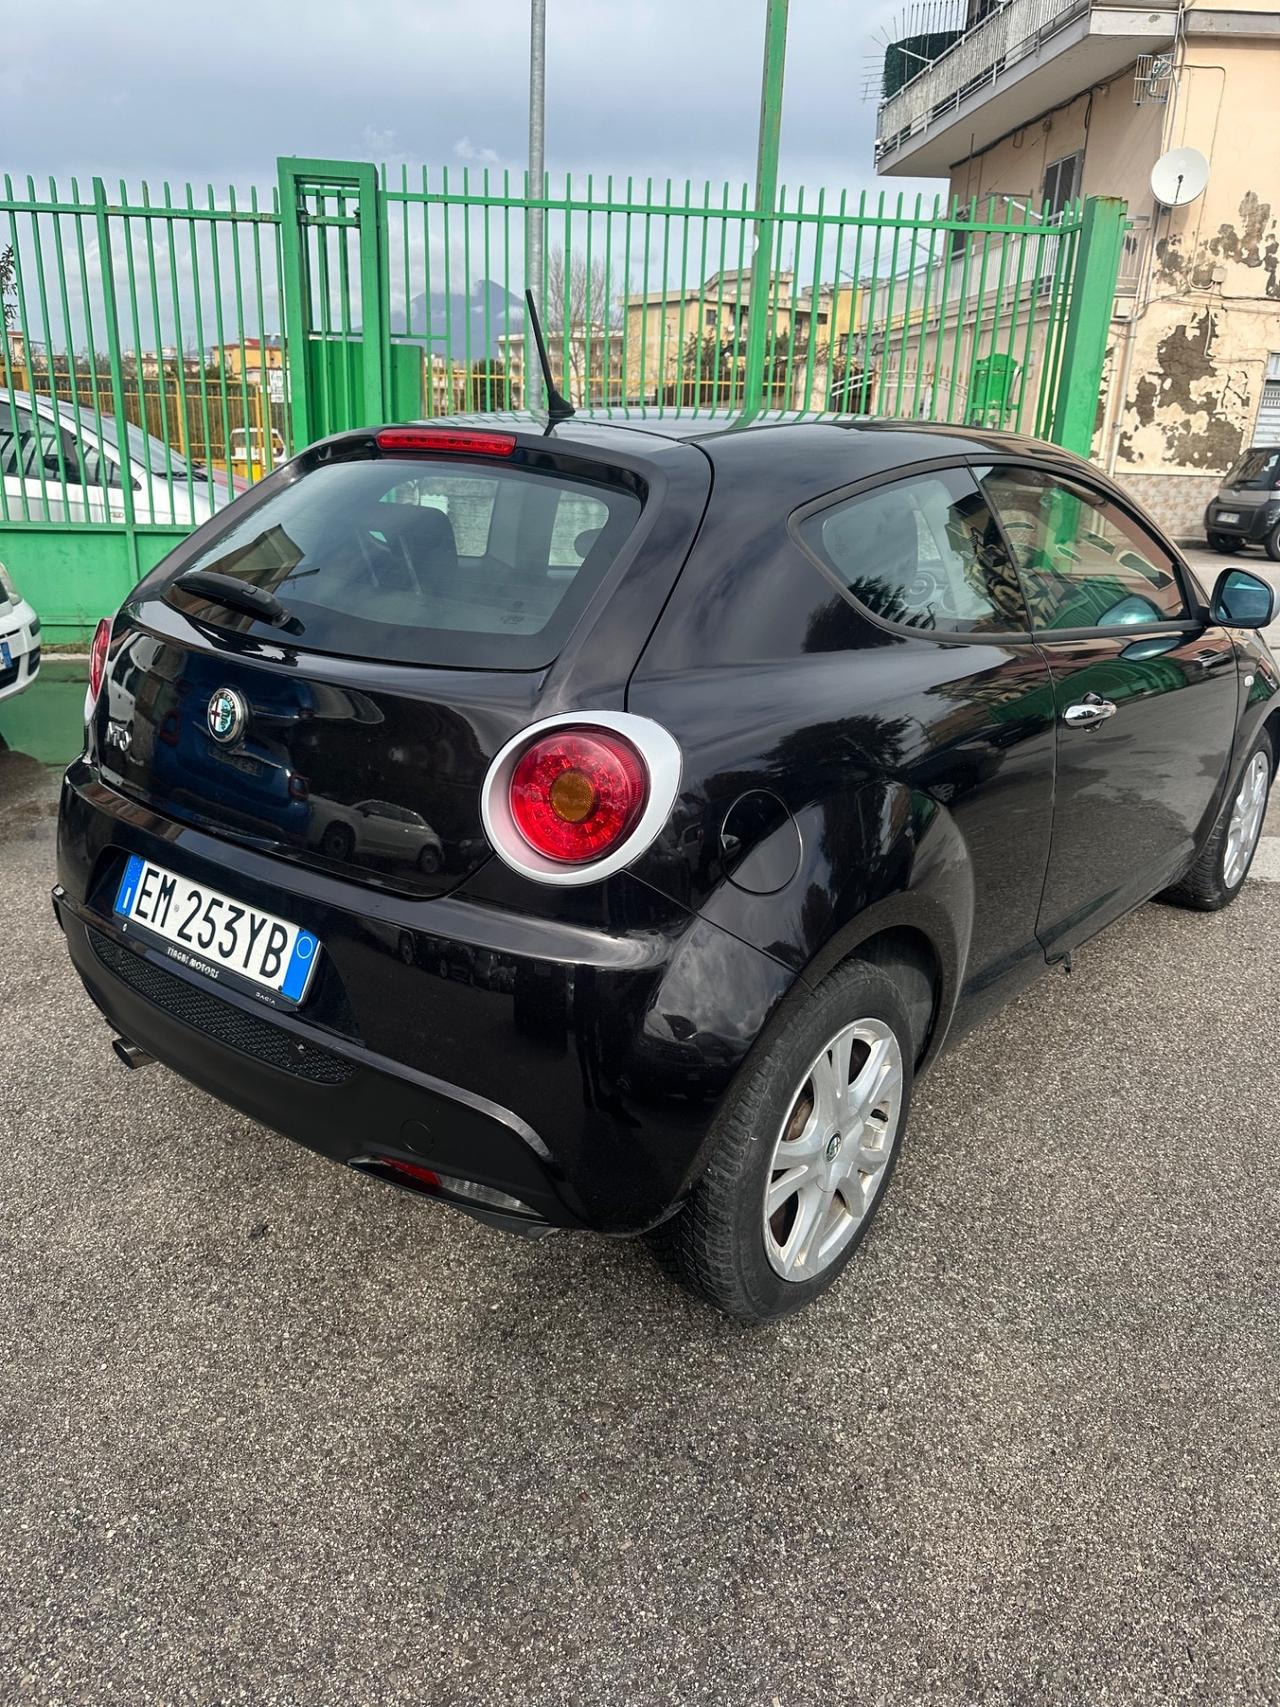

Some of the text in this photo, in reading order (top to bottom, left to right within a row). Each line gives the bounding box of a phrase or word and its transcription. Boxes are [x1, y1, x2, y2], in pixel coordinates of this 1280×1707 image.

[134, 867, 288, 978] EM 253YB
[188, 957, 220, 979] MOTORS
